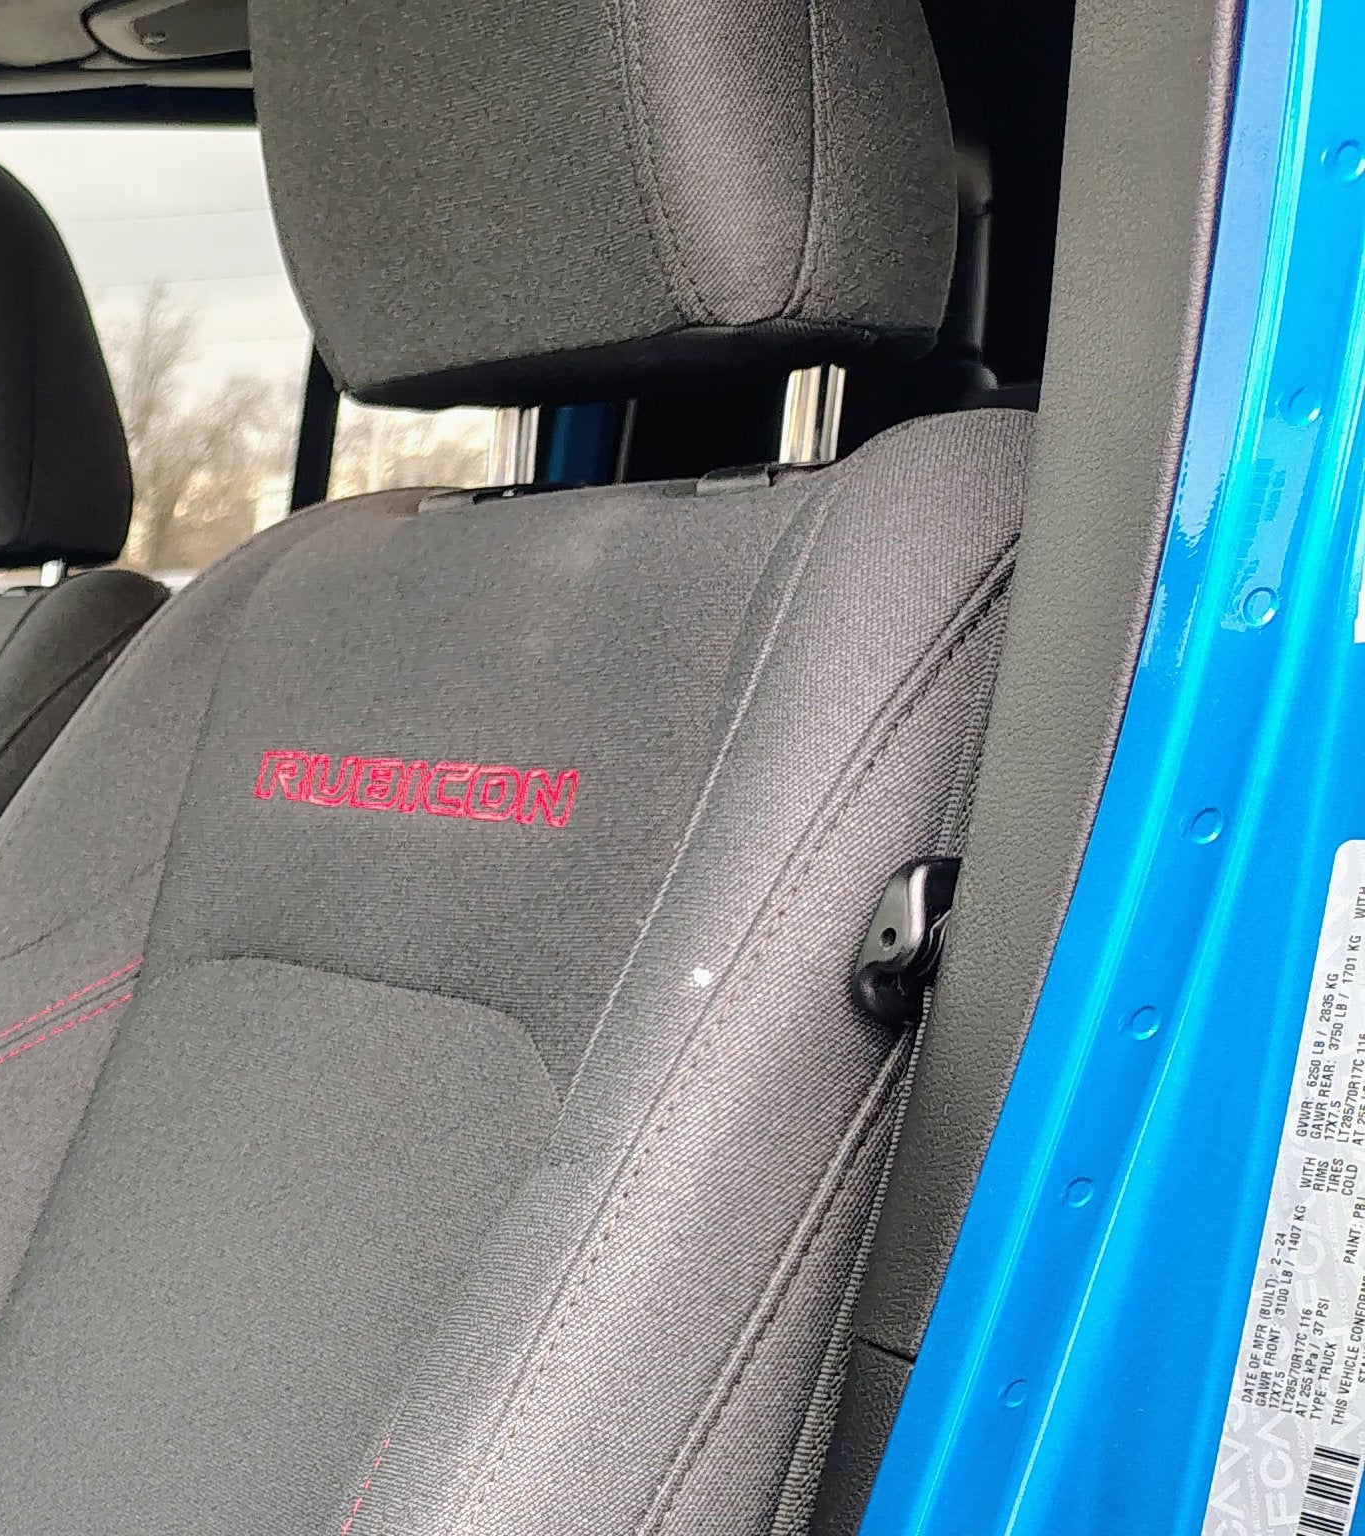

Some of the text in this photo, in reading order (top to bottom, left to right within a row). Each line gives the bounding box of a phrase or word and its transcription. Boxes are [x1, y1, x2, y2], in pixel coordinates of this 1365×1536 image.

[254, 750, 579, 828] RUBICON
[1347, 935, 1362, 951] KG
[1325, 973, 1339, 989] KG
[1342, 957, 1357, 984] 1701
[1319, 994, 1334, 1022] 2835
[1334, 1003, 1348, 1017] LB
[1312, 1040, 1325, 1055] LB
[1329, 1022, 1344, 1050] 3750
[1307, 1059, 1321, 1088] 6250
[1318, 1059, 1337, 1098] REAR:
[1336, 1058, 1365, 1143] LT285/70R17C
[1296, 1097, 1314, 1137] GVWR:
[1310, 1101, 1327, 1140] GAWR
[1324, 1100, 1341, 1141] 17X7.5
[1352, 1129, 1365, 1146] AT
[1299, 1156, 1316, 1188] WITH
[1341, 1164, 1358, 1196] COLD
[1293, 1204, 1307, 1221] KG
[1288, 1225, 1302, 1252] 1407
[1343, 1223, 1364, 1264] PAINT:
[1268, 1160, 1329, 1409] 17X7.5 RIMS
[1280, 1269, 1293, 1285] LB
[1280, 1158, 1343, 1413] LT285/70R17C 116 TIRES
[1259, 1272, 1280, 1320] (BUILT):
[1275, 1287, 1289, 1316] 3100
[1316, 1297, 1331, 1319] PSI
[1253, 1323, 1268, 1350] MFR
[1313, 1321, 1324, 1336] 37
[1267, 1322, 1282, 1367] FRONT:
[1249, 1353, 1261, 1368] OF
[1305, 1352, 1319, 1374] kPa
[1338, 1345, 1360, 1394] VEHICLE
[1241, 1371, 1257, 1404] DATE
[1255, 1370, 1273, 1407] GAWR
[1299, 1377, 1314, 1398] 255
[1309, 1341, 1338, 1420] TYPE: TRUCK
[1295, 1400, 1310, 1418] AT
[1331, 1393, 1348, 1426] THIS
